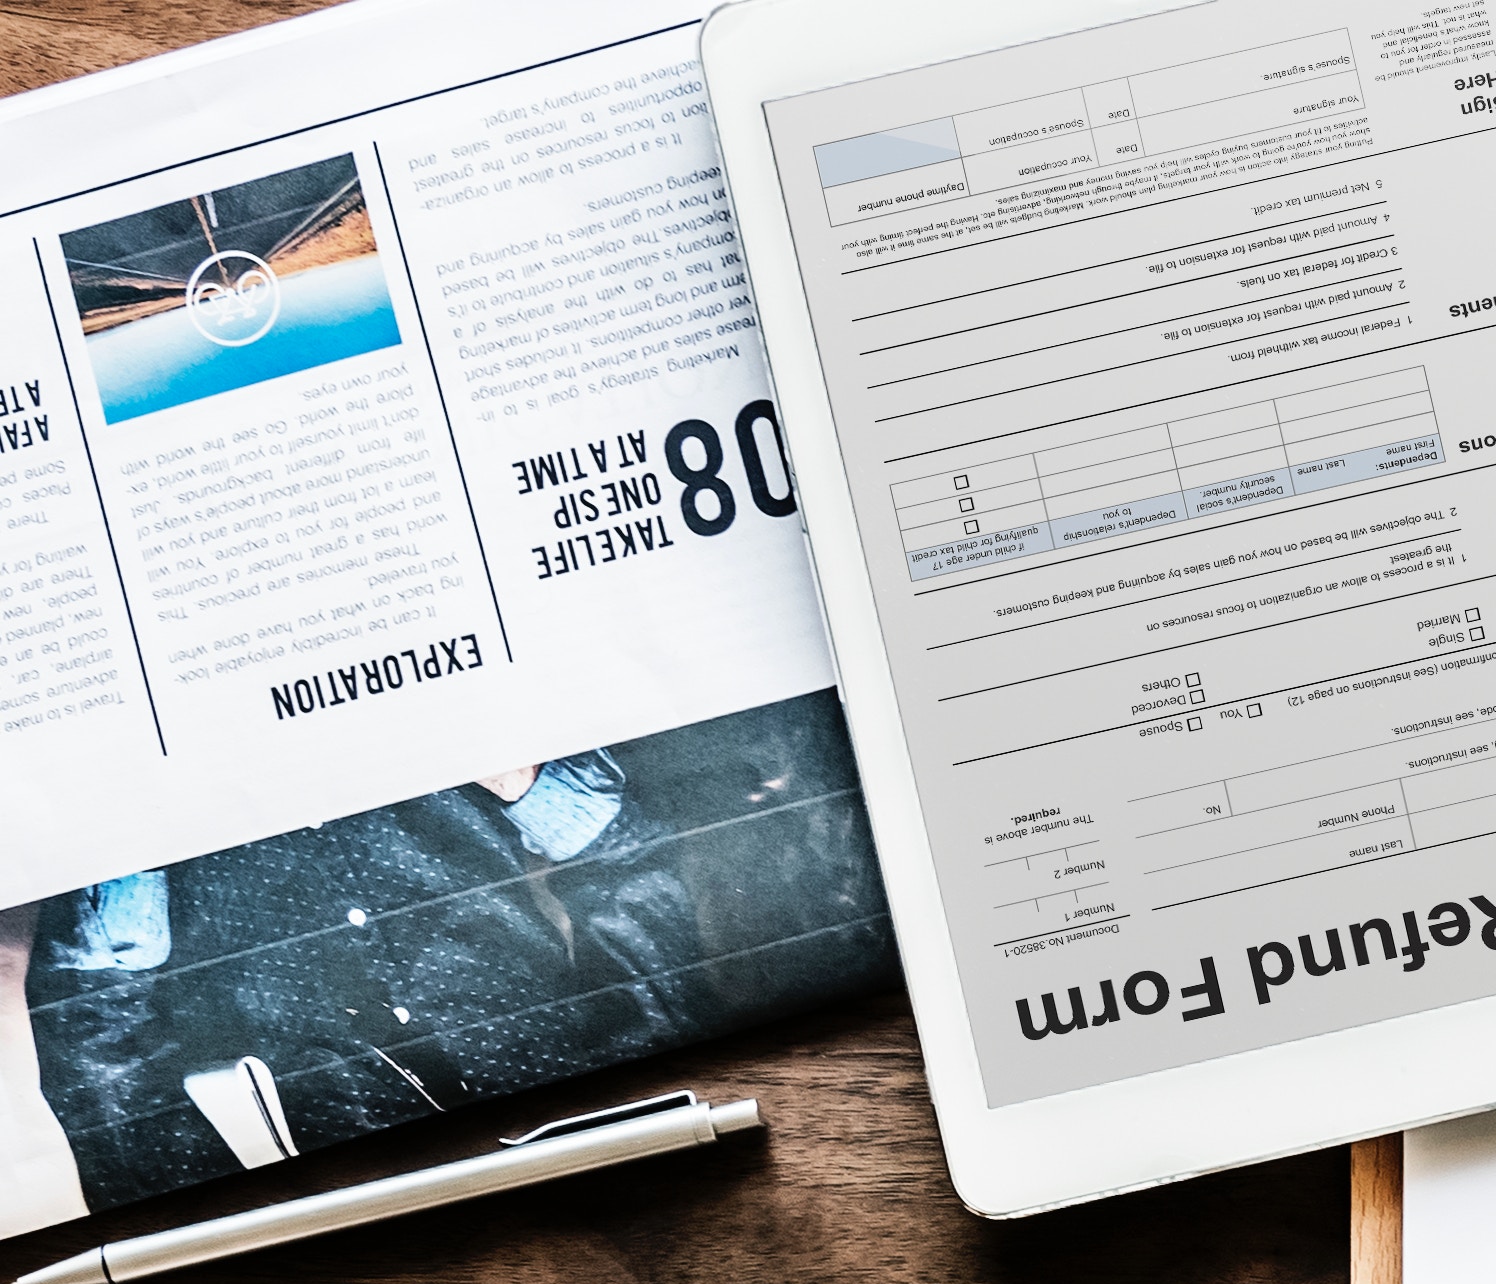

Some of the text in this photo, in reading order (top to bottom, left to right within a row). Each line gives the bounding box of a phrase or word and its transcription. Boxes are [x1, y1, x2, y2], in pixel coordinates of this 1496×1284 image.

[858, 182, 965, 212] Daytime phone number
[511, 429, 647, 495] AT A TIME
[554, 472, 662, 529] ONE SIP
[531, 515, 674, 580] TAKE LIFE
[1416, 614, 1461, 632] Married
[1428, 632, 1465, 647] Single
[269, 632, 484, 721] EXPLORATION
[1141, 677, 1181, 692] Others
[1131, 694, 1186, 716] Devorced
[1010, 807, 1061, 826] required.
[1203, 804, 1221, 815] No.
[1318, 804, 1395, 829] Phone Number
[1349, 839, 1403, 858] Last name
[1053, 860, 1105, 879] Number 2
[1064, 903, 1115, 922] Number 1
[1002, 923, 1123, 960] Document No.38520-1
[1014, 955, 1226, 1042] Form
